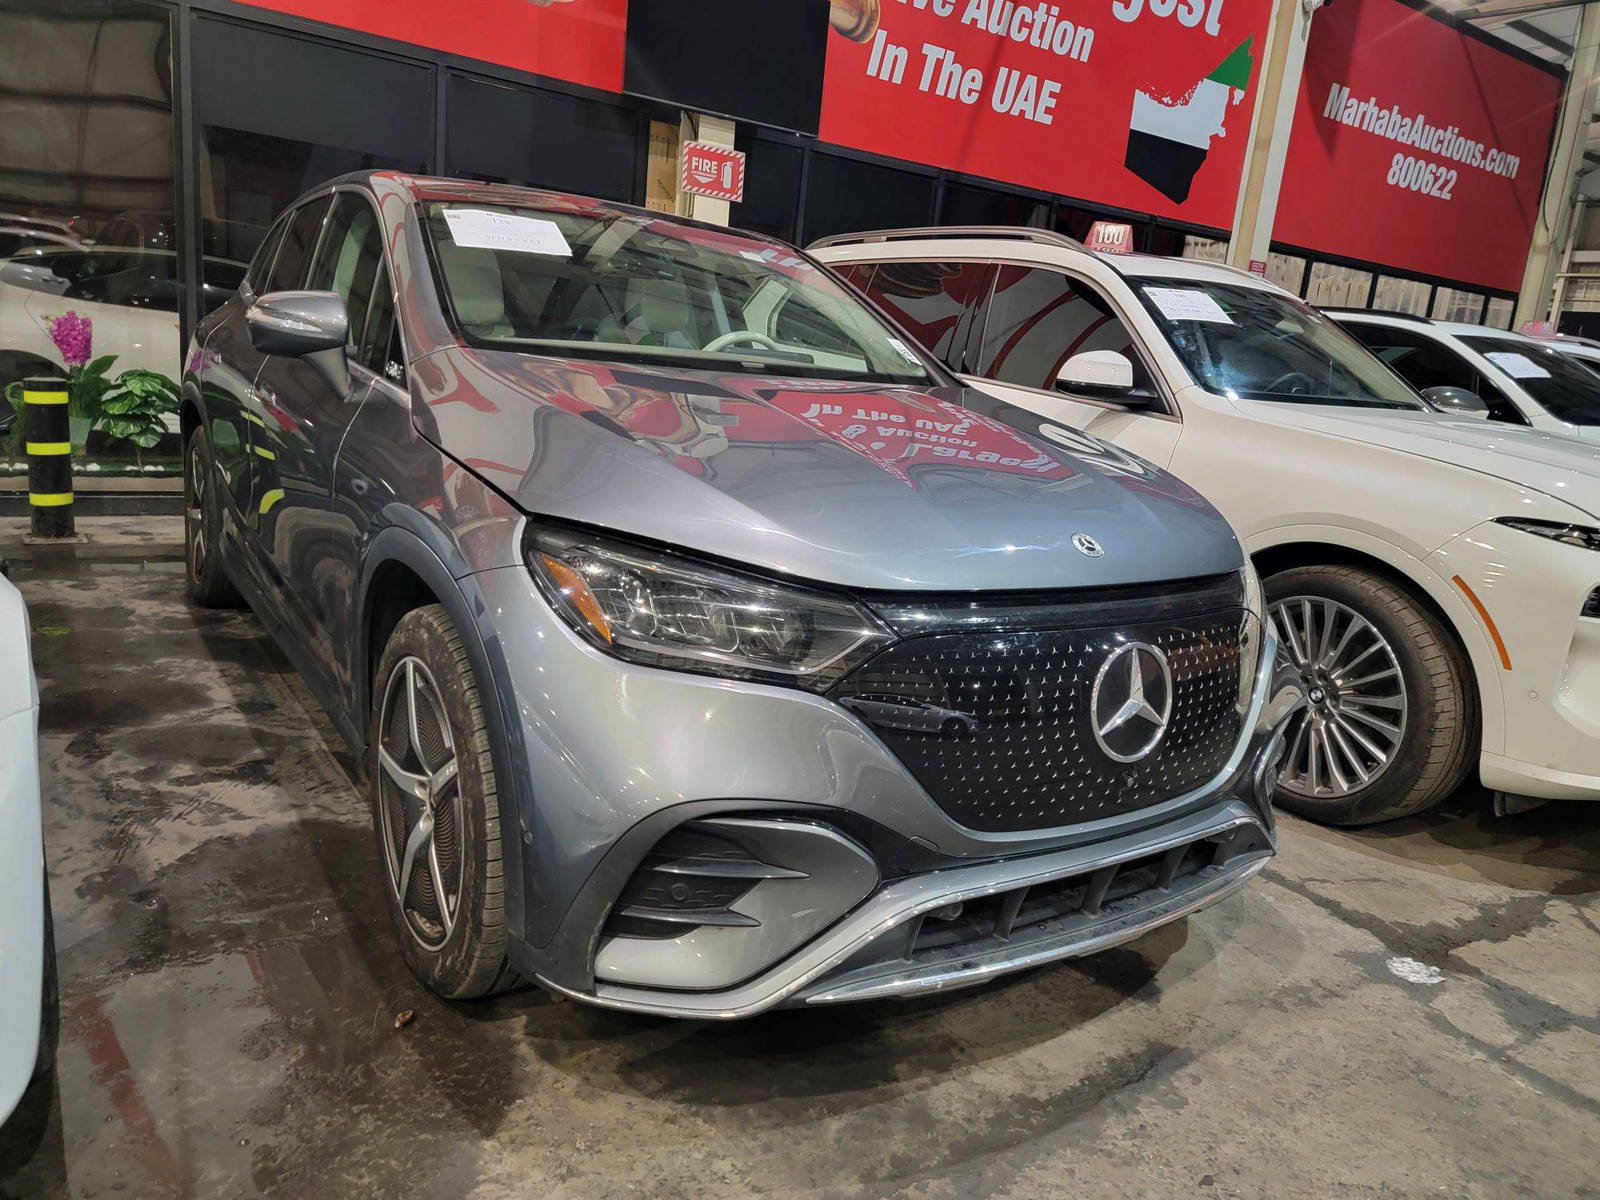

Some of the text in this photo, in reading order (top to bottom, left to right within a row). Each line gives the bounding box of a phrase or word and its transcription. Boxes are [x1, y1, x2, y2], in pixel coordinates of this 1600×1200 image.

[961, 0, 1095, 62] Auction
[866, 29, 1062, 125] In The UAE
[1323, 82, 1520, 179] MarhabaAuctions.com
[692, 157, 718, 175] FIRE
[1387, 152, 1457, 200] 800622
[1097, 224, 1125, 245] 100
